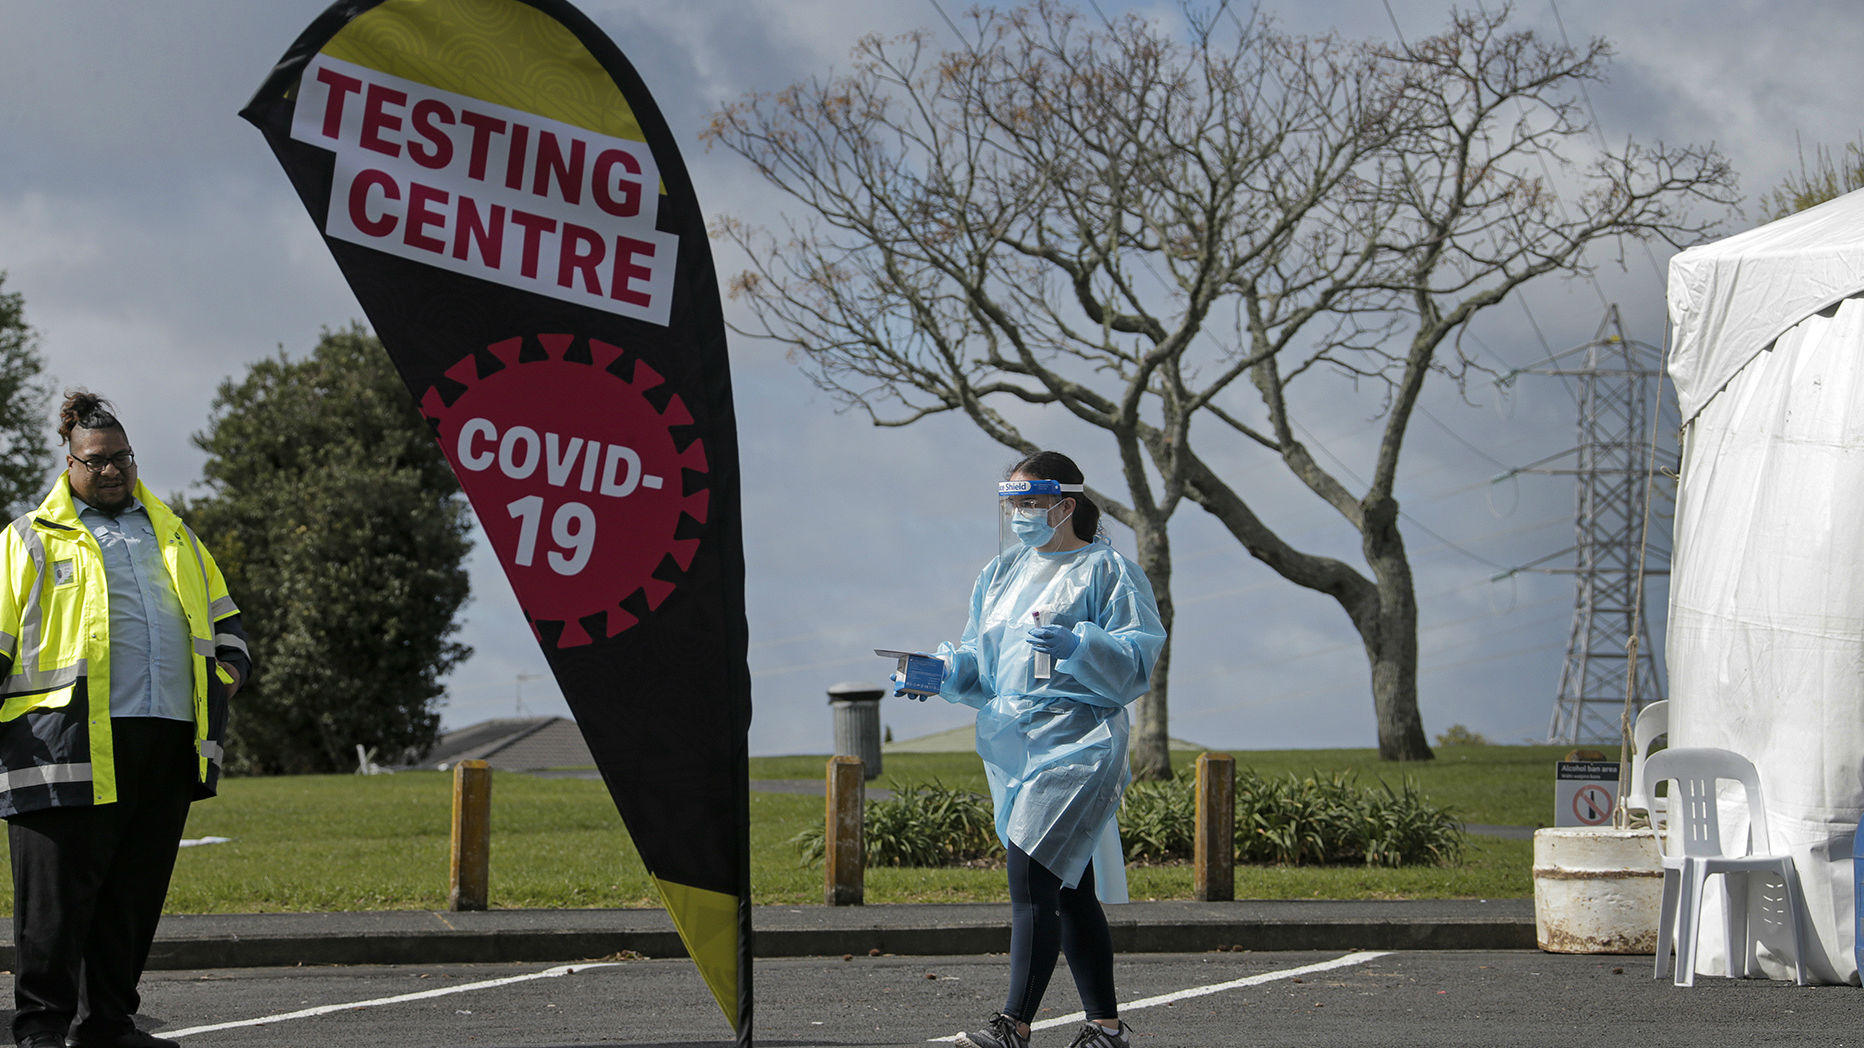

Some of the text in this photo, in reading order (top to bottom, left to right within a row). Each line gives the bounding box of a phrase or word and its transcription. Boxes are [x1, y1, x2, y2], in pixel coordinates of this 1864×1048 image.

[316, 67, 642, 218] TESTING
[348, 168, 656, 308] CENTRE
[457, 417, 664, 498] COVID-
[506, 494, 597, 576] 19
